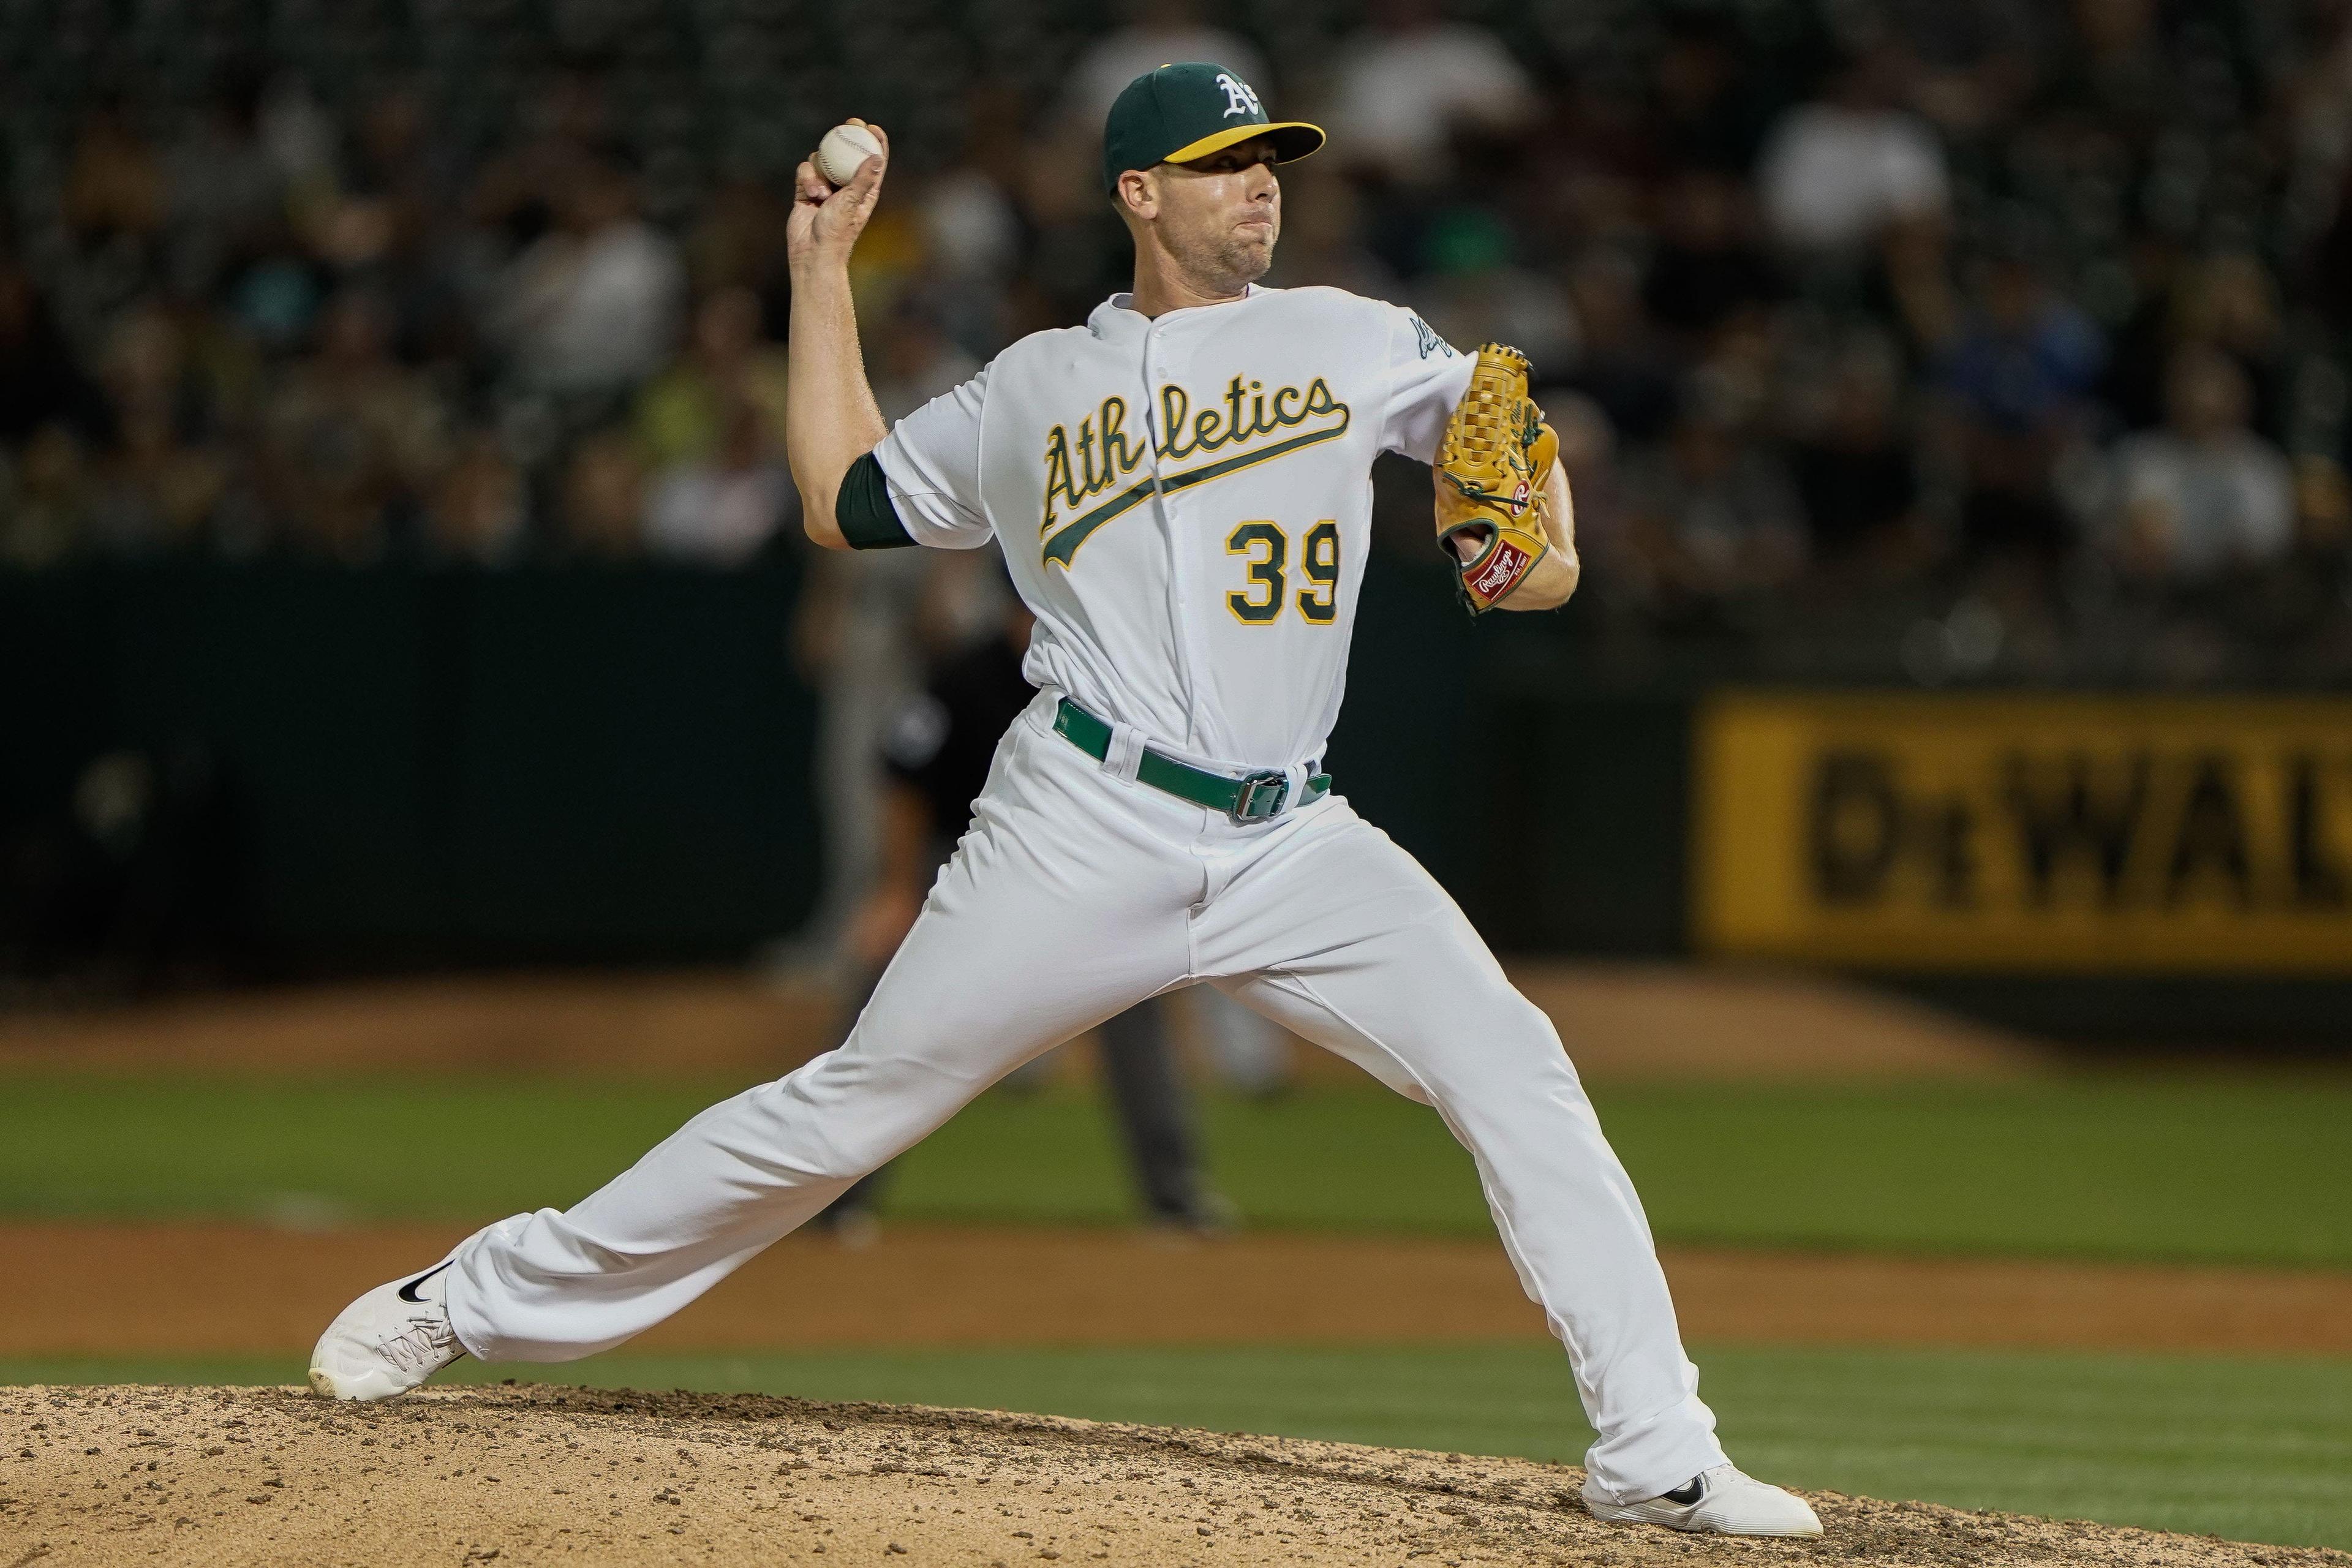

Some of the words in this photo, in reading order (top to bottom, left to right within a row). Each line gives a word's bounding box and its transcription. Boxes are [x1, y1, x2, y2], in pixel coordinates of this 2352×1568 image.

[1216, 74, 1259, 118] A's
[1039, 372, 1349, 540] Athletics
[1225, 519, 1340, 625] 39
[1479, 549, 1513, 593] Rawlings
